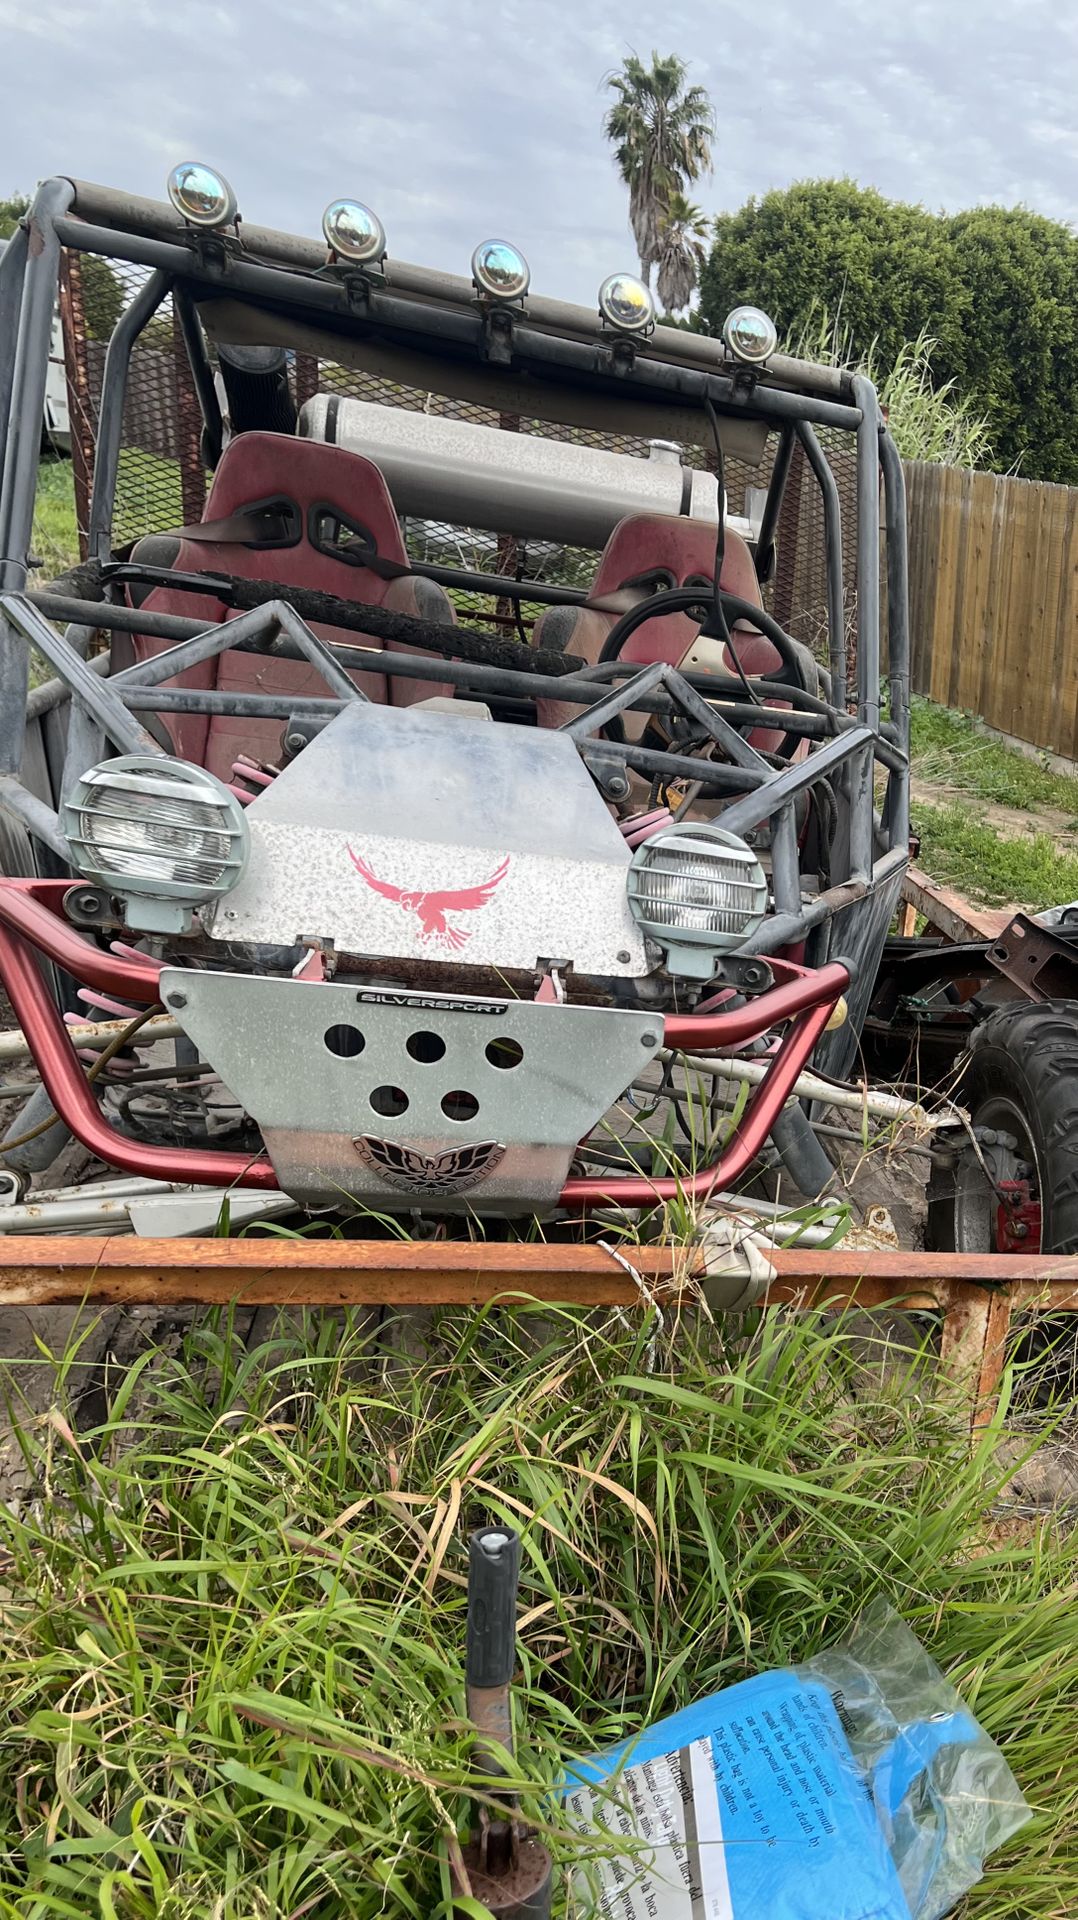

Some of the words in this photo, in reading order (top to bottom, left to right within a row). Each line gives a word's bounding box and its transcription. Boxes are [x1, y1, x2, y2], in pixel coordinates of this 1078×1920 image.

[361, 993, 505, 1013] SILVERSPORT
[353, 1140, 448, 1196] COLLECTOR
[453, 1148, 507, 1192] EDITION
[745, 1714, 756, 1727] can
[712, 1726, 727, 1741] This
[728, 1719, 754, 1754] suffocation.
[751, 1727, 765, 1745] cause
[773, 1730, 787, 1743] the
[717, 1739, 738, 1764] plastic
[757, 1743, 784, 1775] personal
[779, 1741, 797, 1761] head
[663, 1747, 695, 1805] Advertencia:
[729, 1762, 745, 1780] bag
[789, 1760, 806, 1776] and
[796, 1739, 818, 1766] plastic
[811, 1764, 837, 1797] material
[741, 1786, 755, 1801] not
[773, 1772, 796, 1798] injury
[798, 1776, 812, 1794] nose
[718, 1781, 740, 1816] children.
[789, 1798, 800, 1809] or
[808, 1795, 819, 1806] or
[634, 1802, 646, 1816] los
[640, 1815, 656, 1839] niños.
[751, 1809, 765, 1824] toy
[795, 1809, 816, 1835] death
[814, 1807, 837, 1835] mouth
[759, 1824, 771, 1835] to
[651, 1793, 664, 1808] esta
[658, 1807, 674, 1828] bolsa
[678, 1859, 694, 1884] fuera
[688, 1884, 702, 1901] del
[765, 1835, 778, 1848] be
[805, 1834, 822, 1849] by
[644, 1893, 658, 1917] boca
